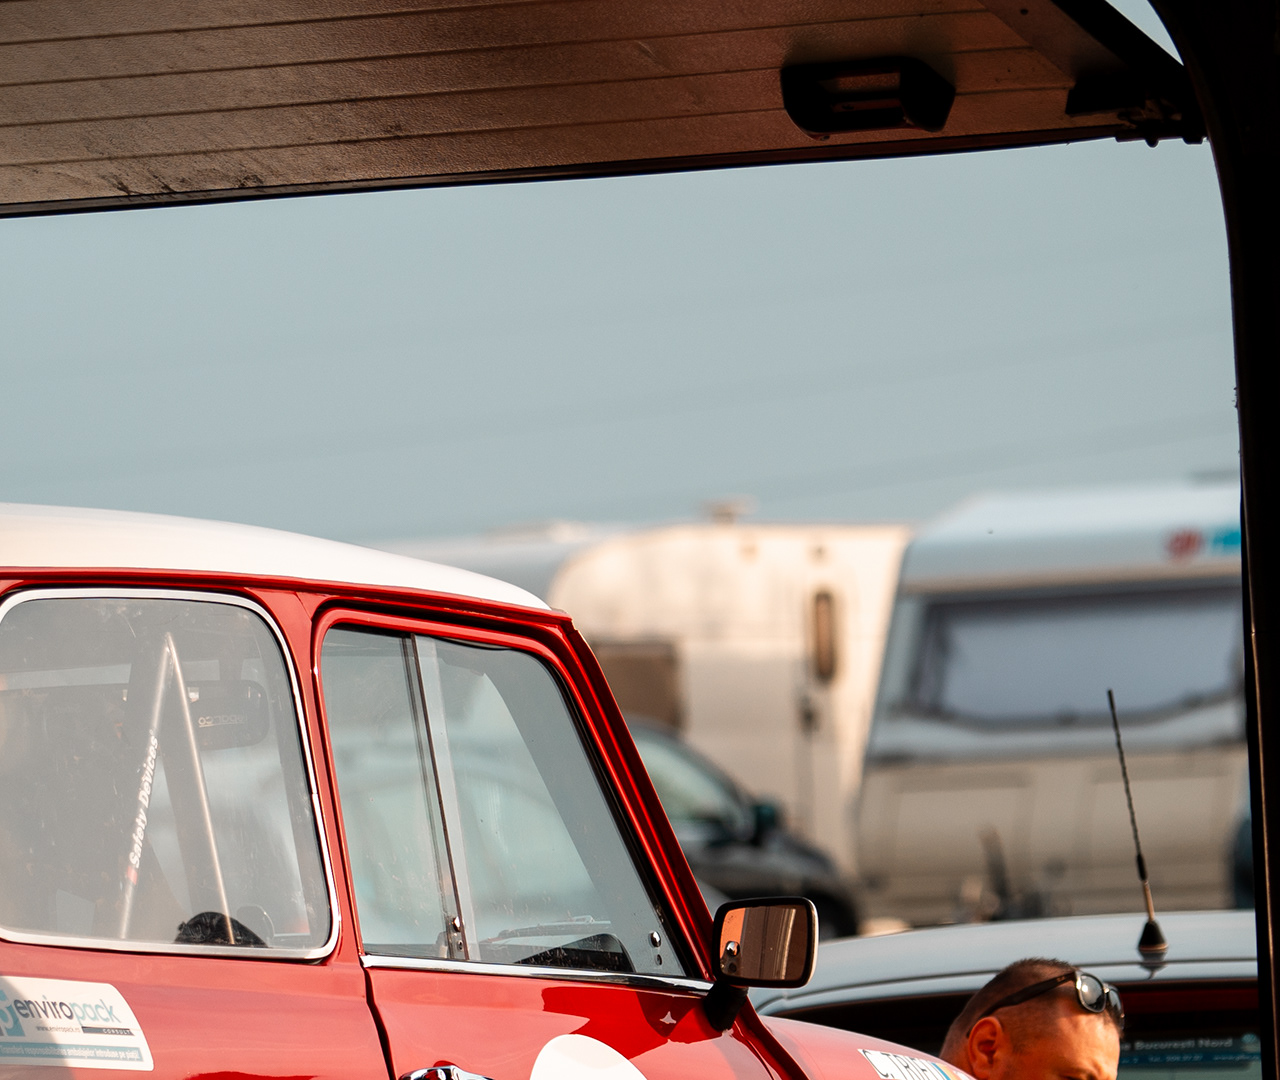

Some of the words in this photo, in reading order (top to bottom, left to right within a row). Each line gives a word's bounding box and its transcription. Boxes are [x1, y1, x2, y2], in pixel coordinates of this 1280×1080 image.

[138, 734, 158, 808] Devices
[129, 807, 148, 869] Safety
[14, 996, 122, 1025] enviropack
[102, 1028, 132, 1036] CONSULT
